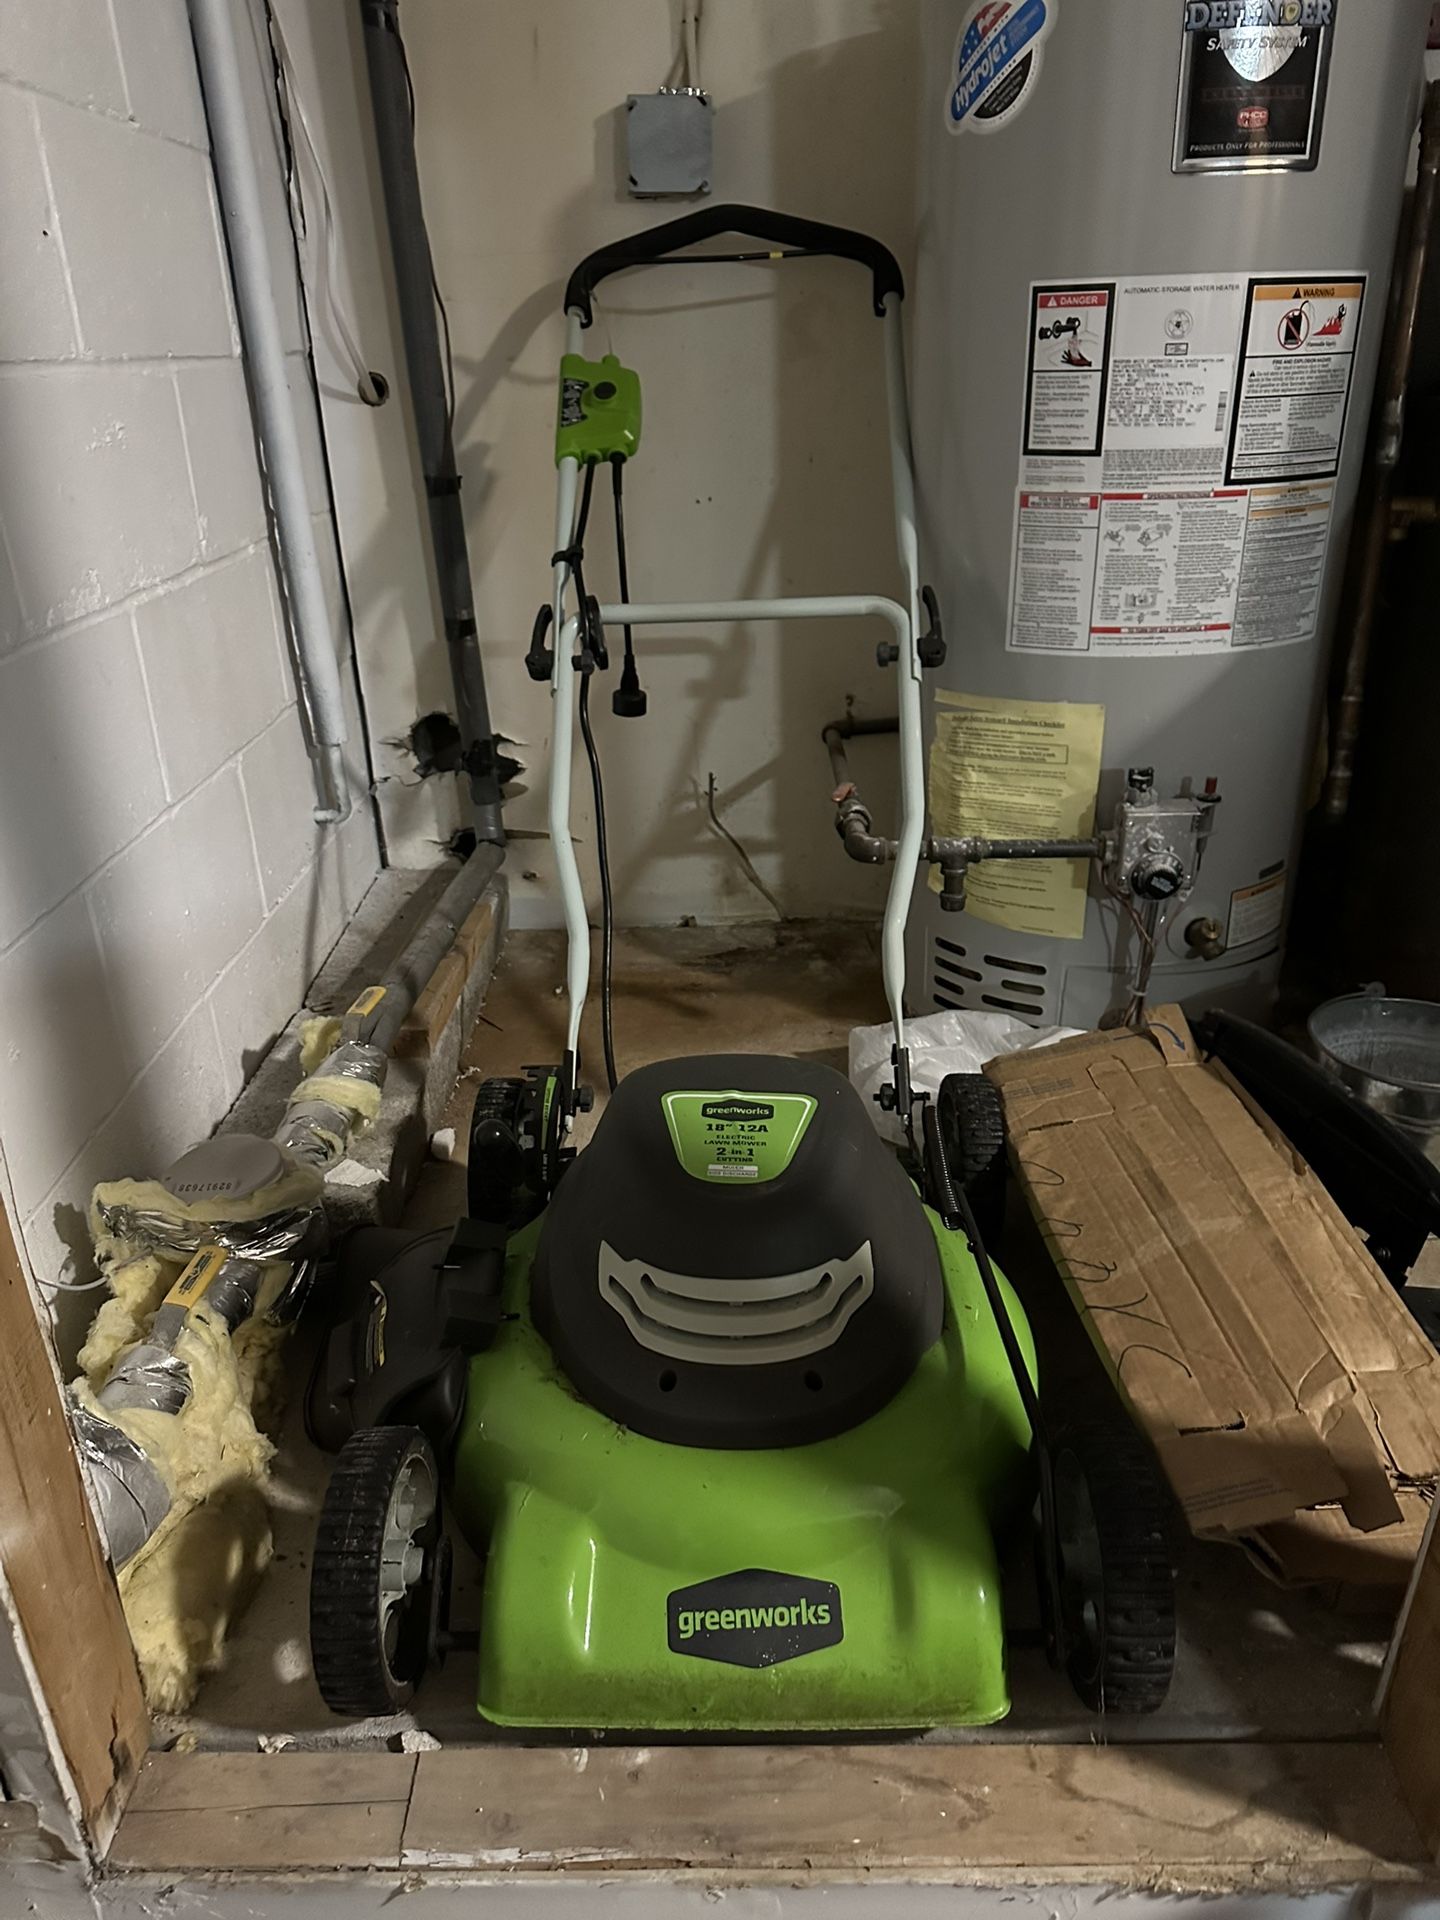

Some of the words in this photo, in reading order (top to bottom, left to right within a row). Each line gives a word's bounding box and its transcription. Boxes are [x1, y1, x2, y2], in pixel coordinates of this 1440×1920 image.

[1187, 0, 1332, 29] DEFENDER
[955, 35, 1008, 112] Hydrojet
[1189, 144, 1226, 152] PRODUCTS
[1226, 142, 1243, 150] ONLY
[1124, 286, 1160, 295] AUTOMATIC
[1162, 285, 1191, 293] STORAGE
[1192, 284, 1215, 292] WATER
[1216, 284, 1240, 292] HEATER
[1303, 288, 1335, 297] WARNING
[1060, 295, 1098, 306] DANGER
[706, 1106, 770, 1115] greenworks
[738, 1124, 769, 1133] 12A
[677, 1598, 831, 1639] greenworks
